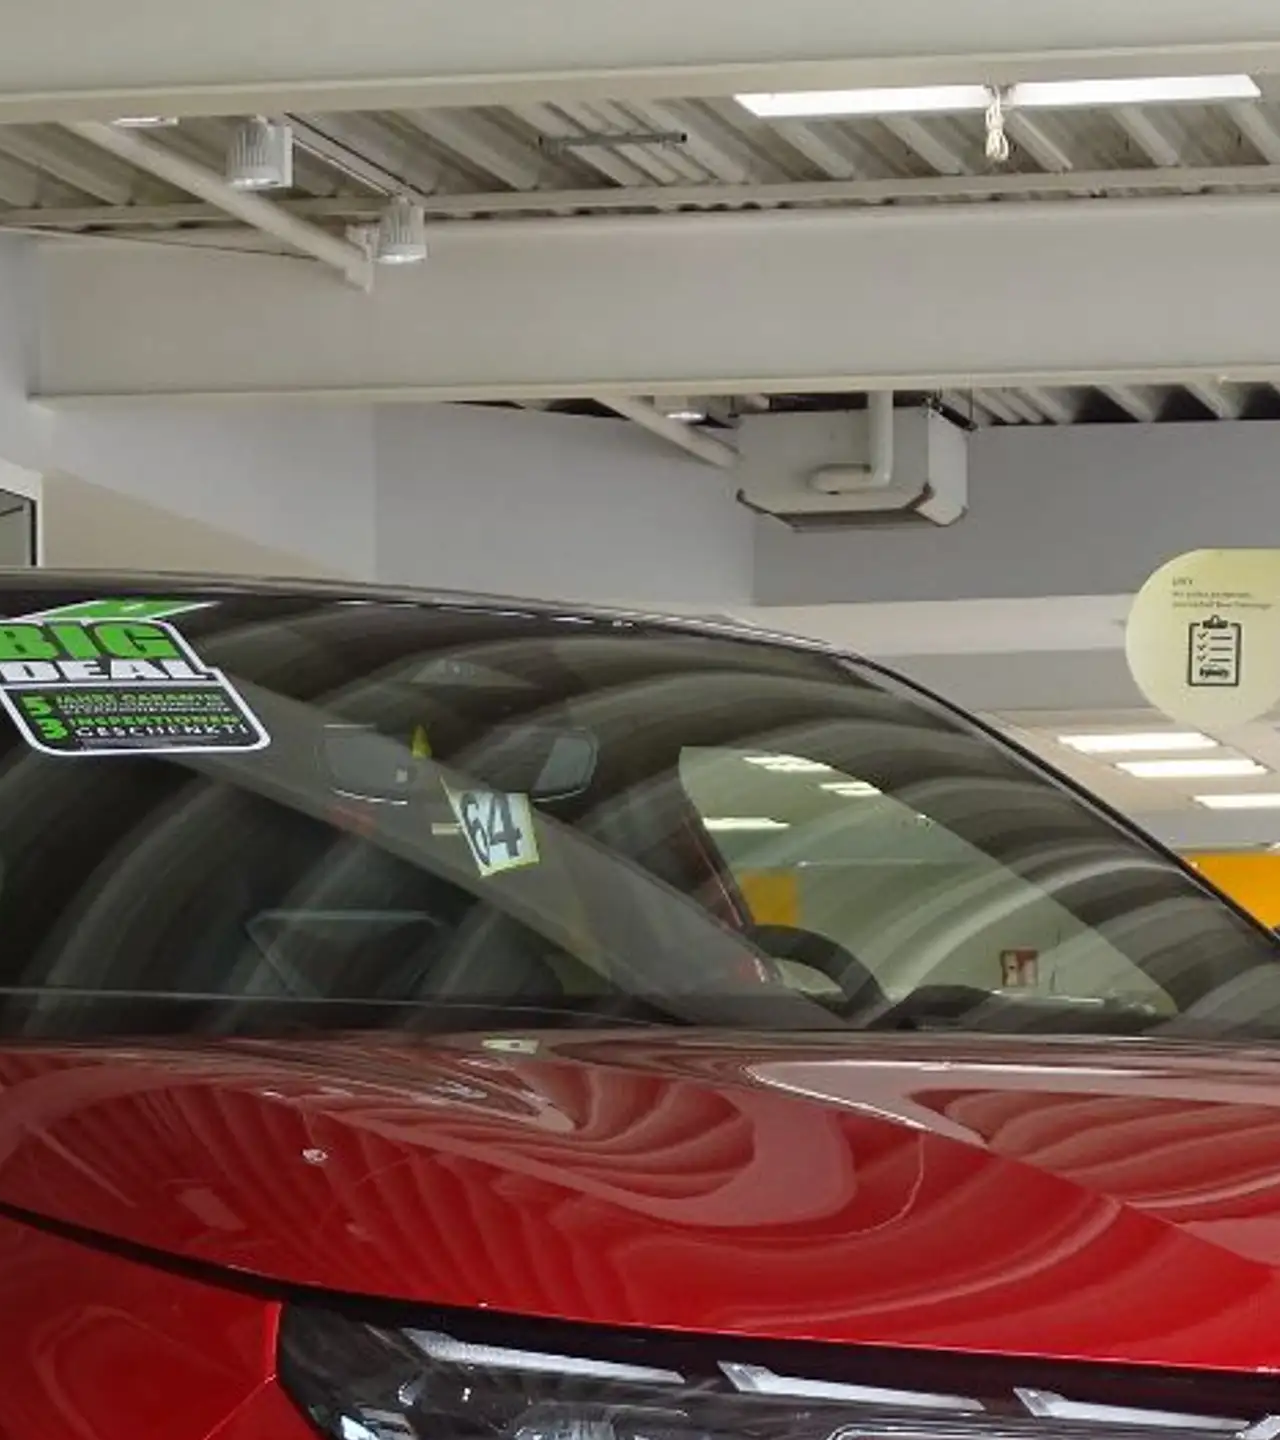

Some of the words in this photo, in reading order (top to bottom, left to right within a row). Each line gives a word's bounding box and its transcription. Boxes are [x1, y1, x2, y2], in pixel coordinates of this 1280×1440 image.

[22, 695, 52, 716] 5
[35, 717, 68, 740] 3
[460, 791, 523, 868] 64
